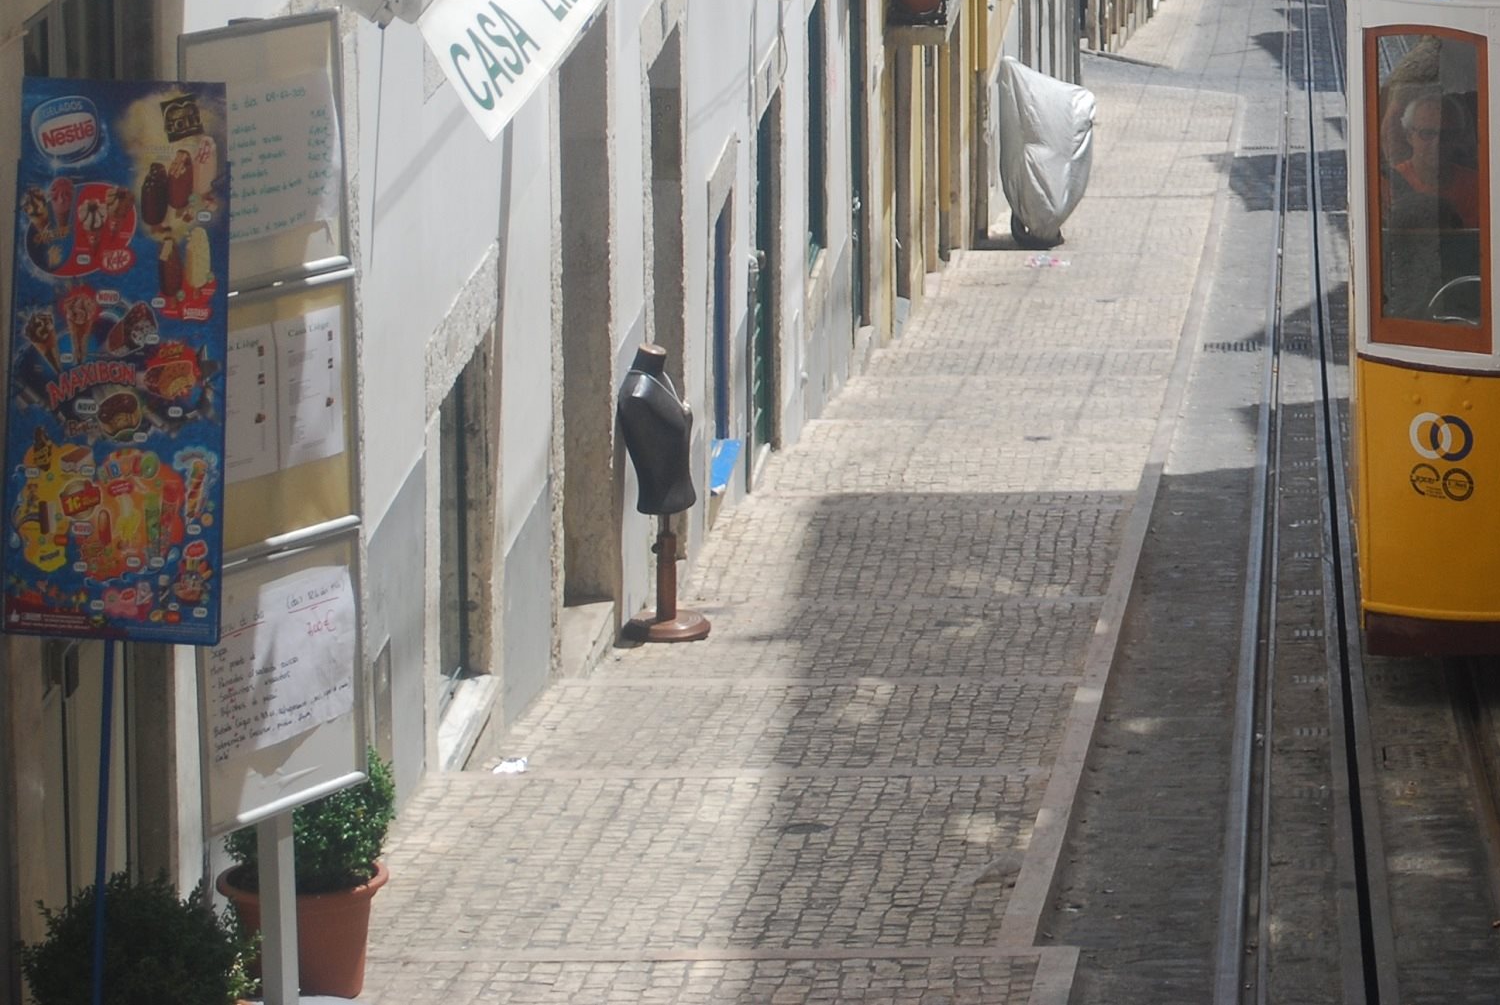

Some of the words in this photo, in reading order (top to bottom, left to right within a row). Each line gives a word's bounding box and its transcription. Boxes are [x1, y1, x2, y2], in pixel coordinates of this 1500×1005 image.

[449, 0, 541, 112] CASA
[42, 100, 83, 118] GELADOS
[41, 119, 95, 150] Nestlé
[46, 361, 137, 410] MAXIBON
[77, 402, 97, 412] NOVO
